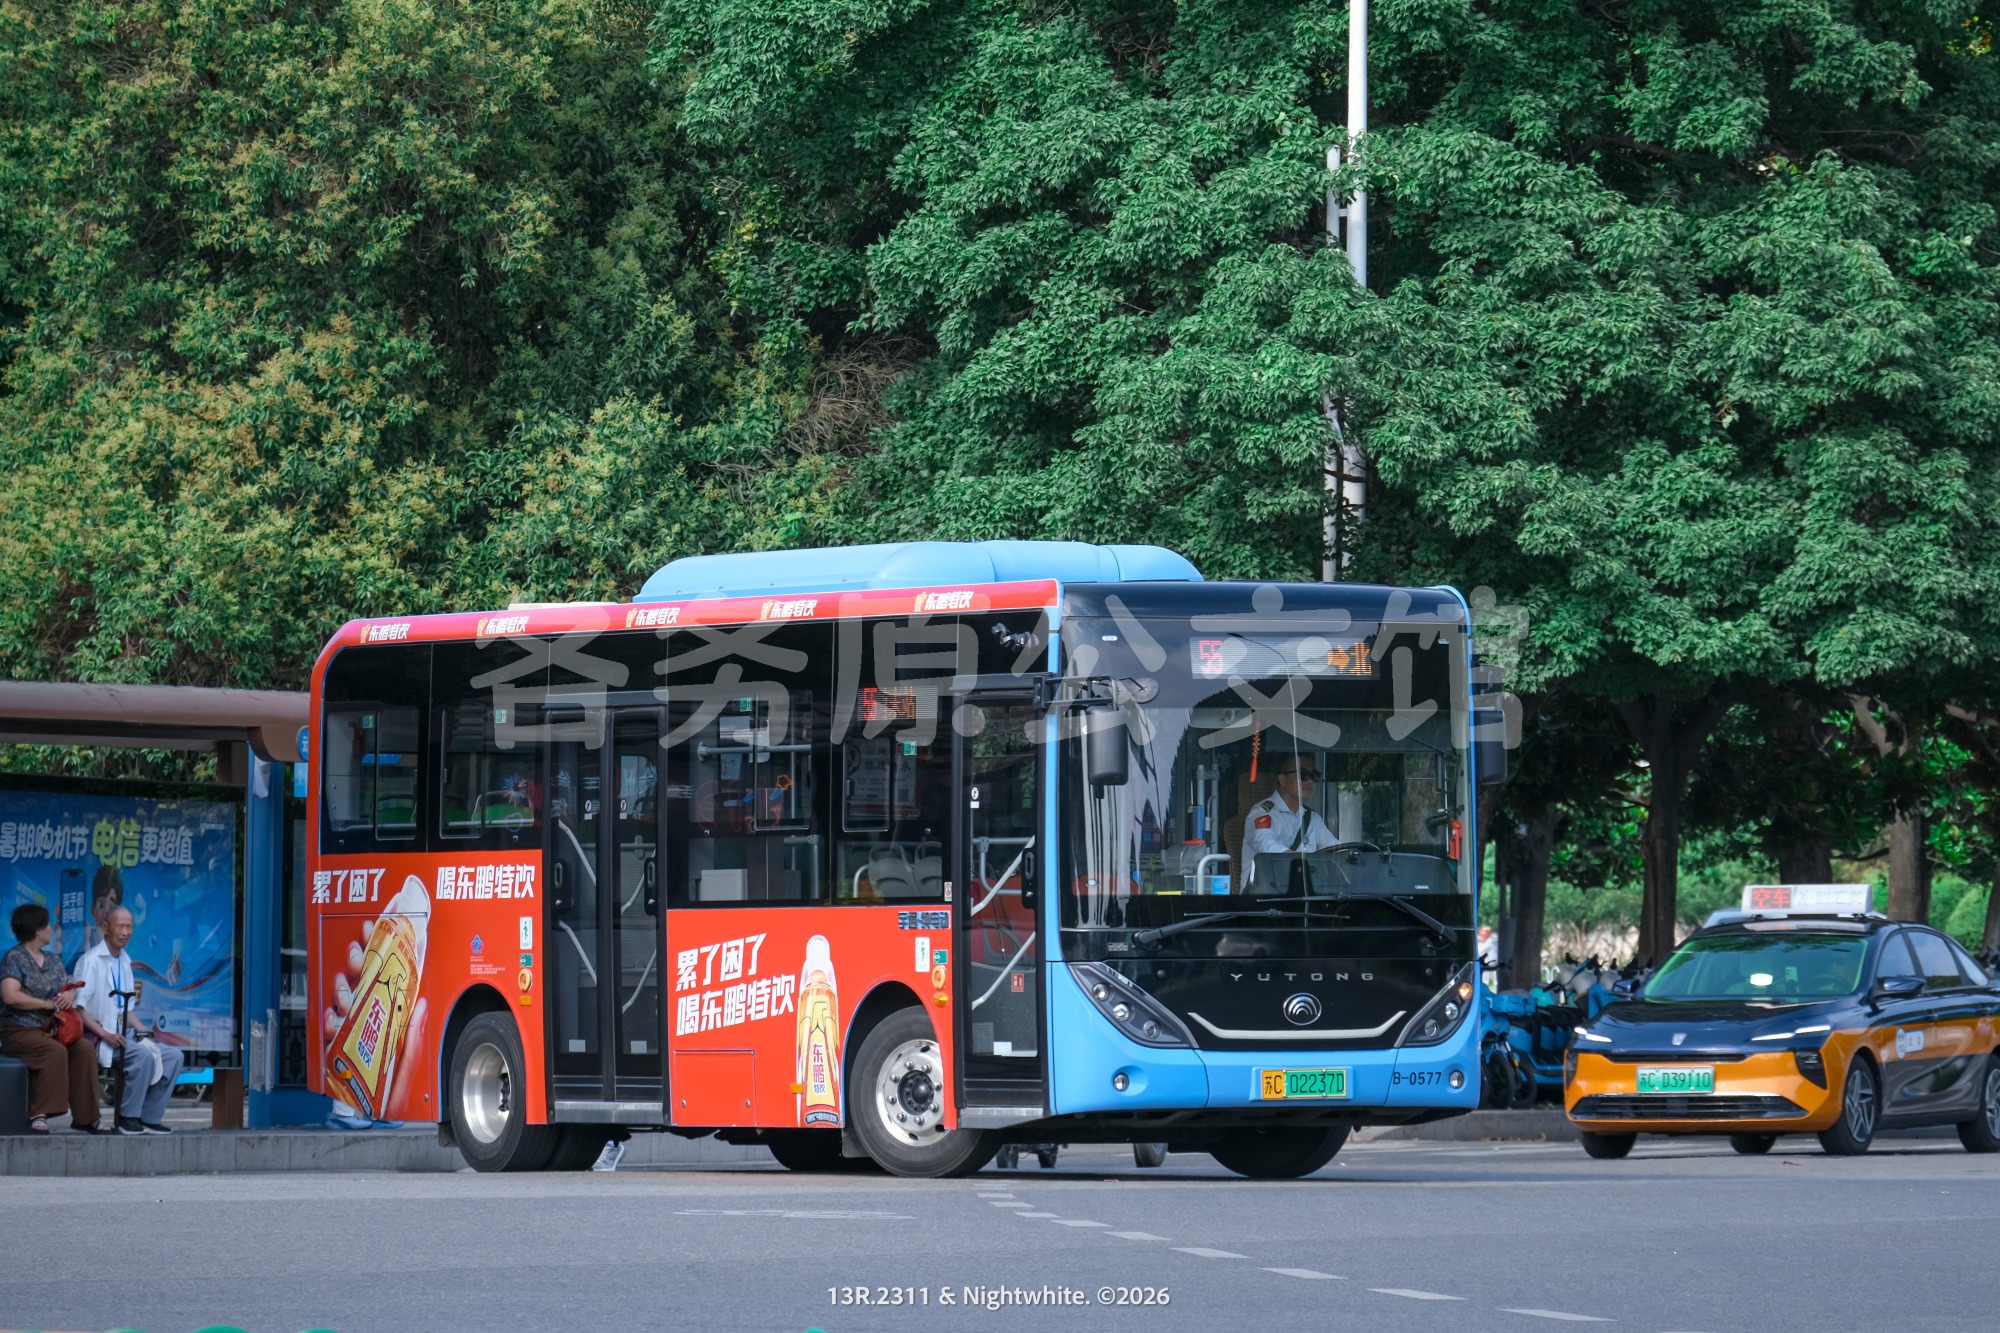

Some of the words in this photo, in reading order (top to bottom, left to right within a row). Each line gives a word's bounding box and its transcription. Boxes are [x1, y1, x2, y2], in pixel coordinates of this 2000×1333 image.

[1199, 640, 1224, 674] 55
[311, 868, 386, 904] 累了困了
[436, 863, 536, 900] 喝东鹏特饮
[1752, 888, 1791, 909] 空车
[675, 933, 767, 992] 累了困了
[1230, 972, 1374, 982] YUTONG
[675, 973, 796, 1037] 喝东鹏特饮
[1393, 1071, 1442, 1086] B-0577
